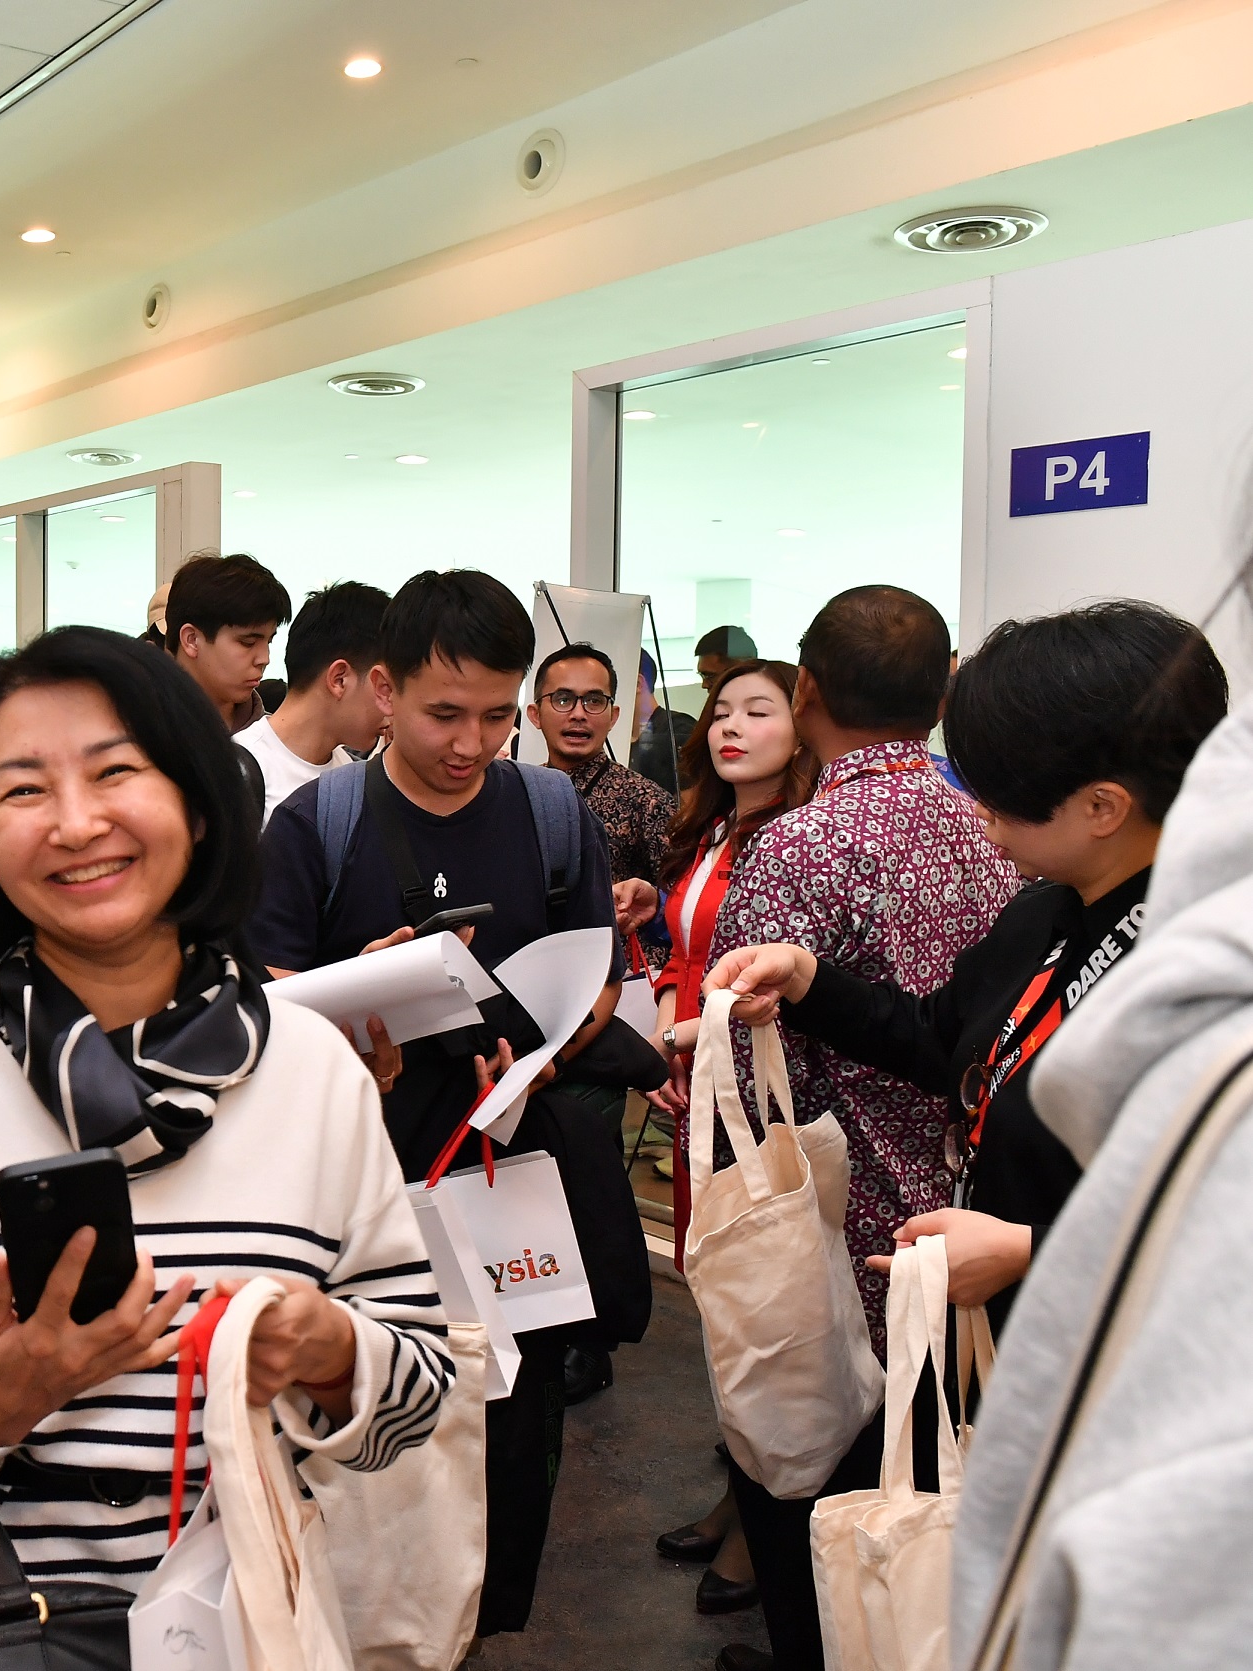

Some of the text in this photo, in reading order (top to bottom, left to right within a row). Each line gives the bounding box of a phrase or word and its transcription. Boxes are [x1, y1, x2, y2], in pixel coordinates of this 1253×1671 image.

[1045, 451, 1110, 501] P4
[1065, 903, 1148, 1010] DARE TO
[988, 1047, 1022, 1100] Allstars
